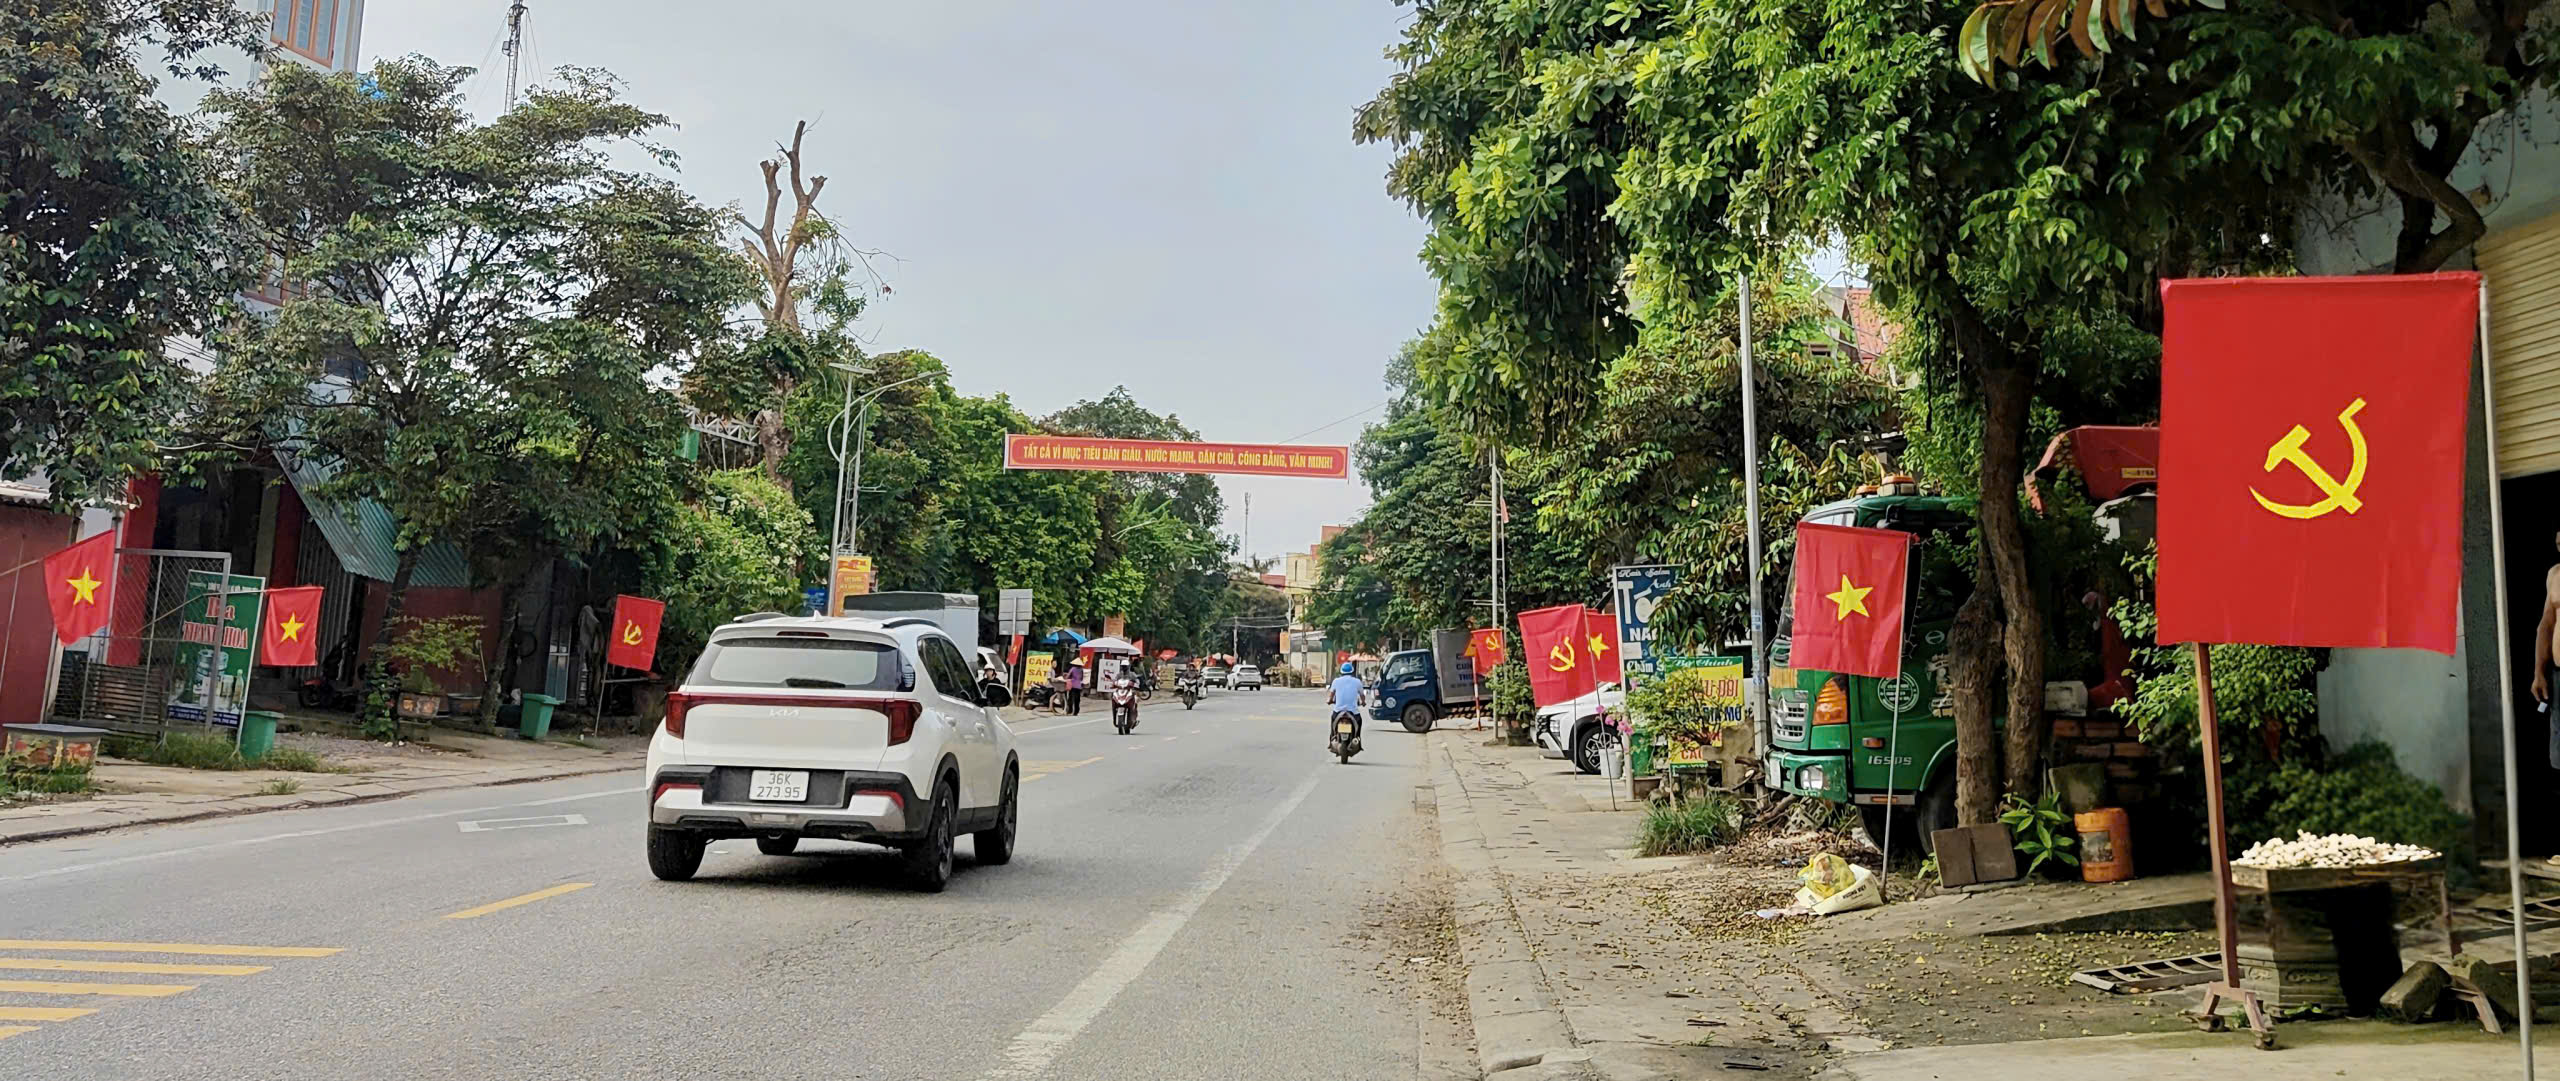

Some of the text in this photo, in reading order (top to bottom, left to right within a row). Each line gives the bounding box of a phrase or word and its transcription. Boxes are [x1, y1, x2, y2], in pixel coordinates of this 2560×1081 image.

[1062, 447, 1081, 462] MỤC
[769, 708, 800, 718] KIA
[768, 772, 792, 785] 36K
